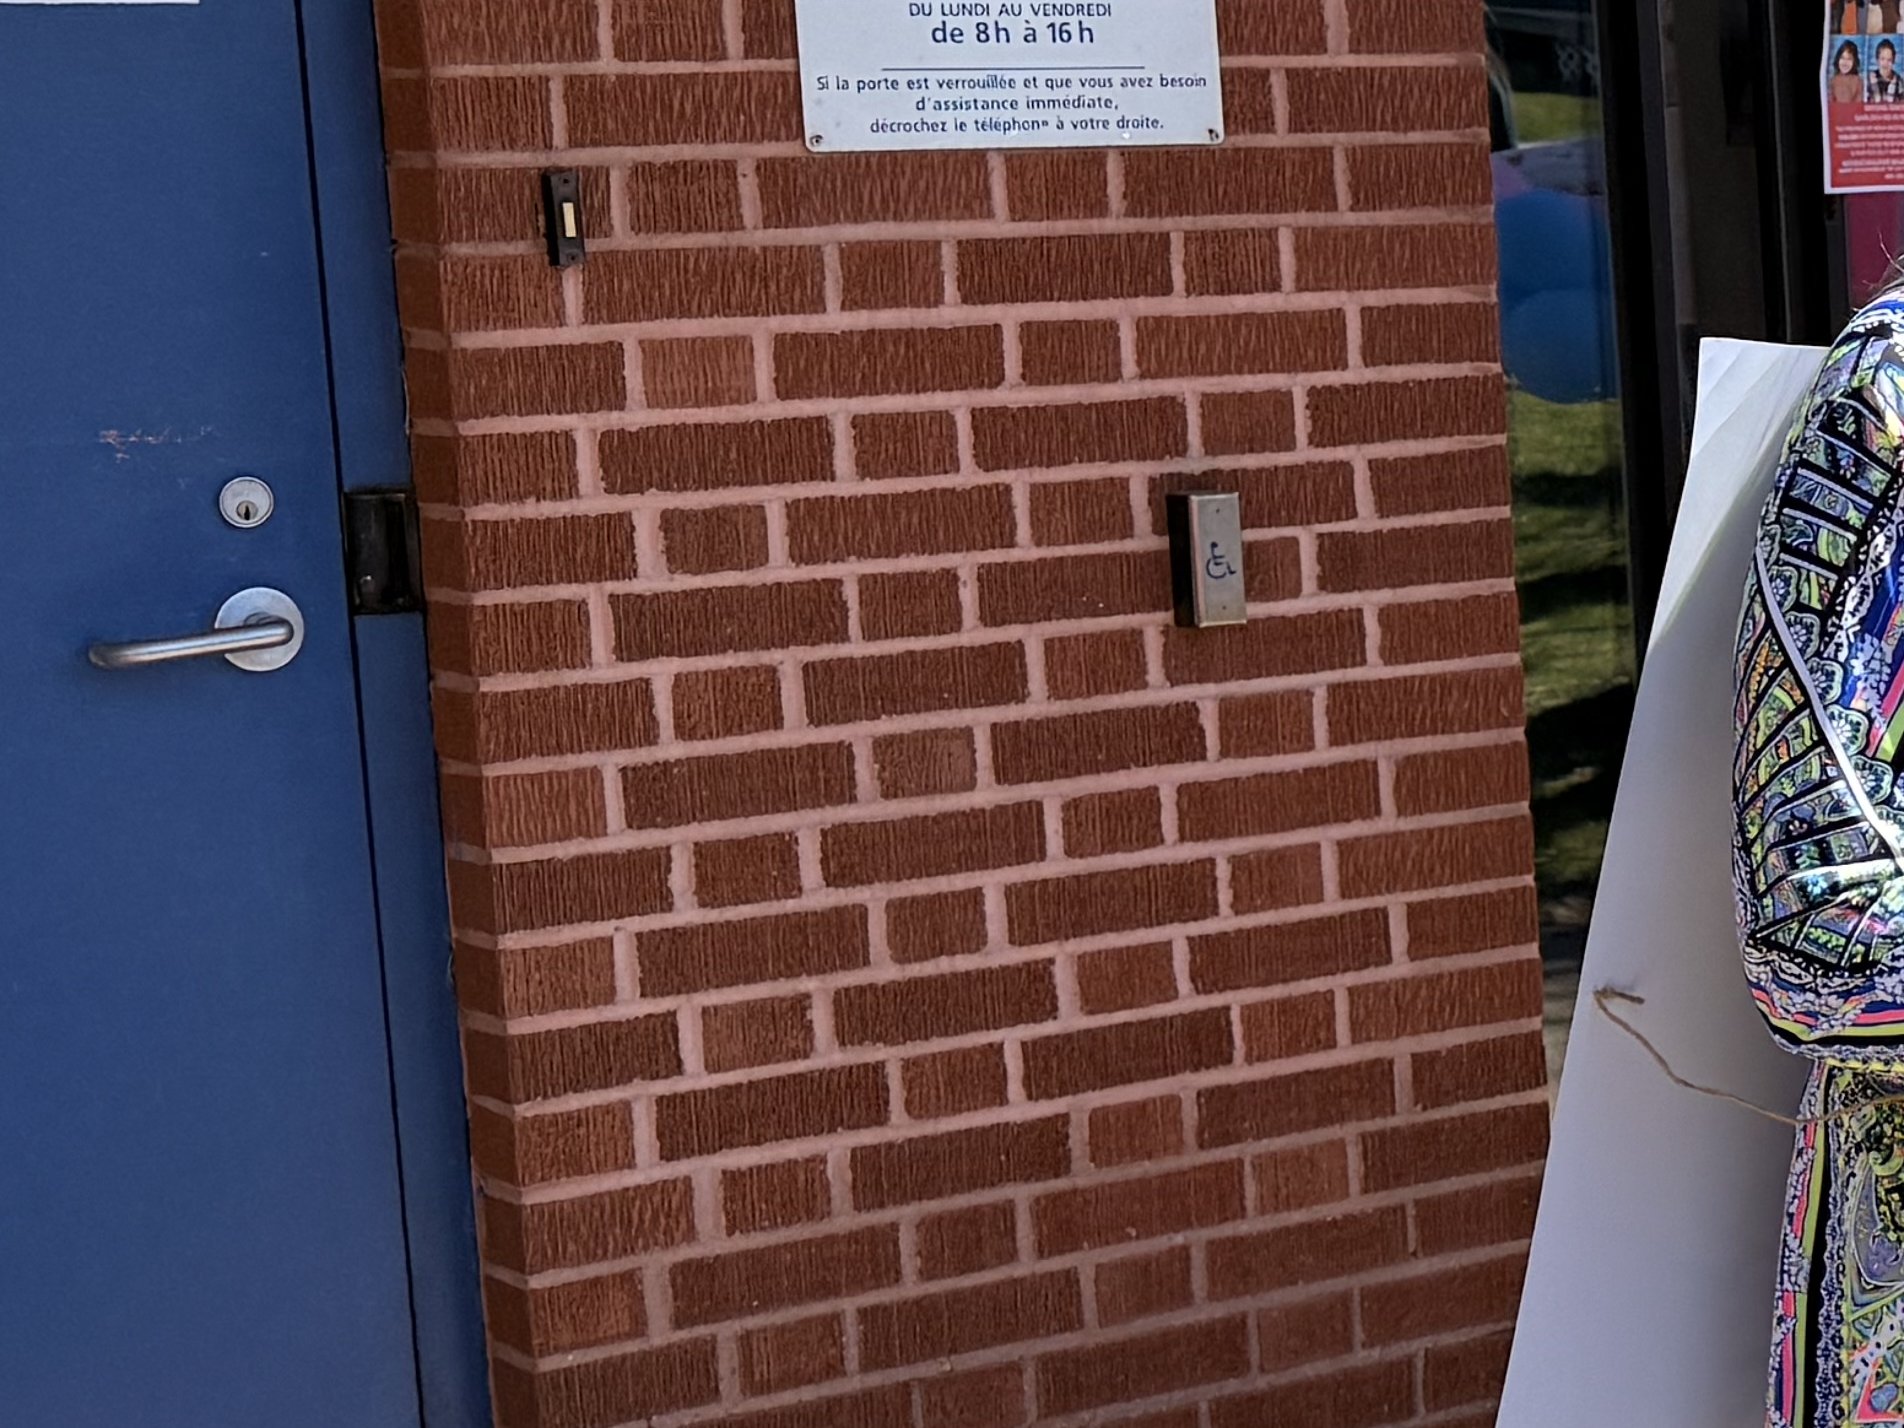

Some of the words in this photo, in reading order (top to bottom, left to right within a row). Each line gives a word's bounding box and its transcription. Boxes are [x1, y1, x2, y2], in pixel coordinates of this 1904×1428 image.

[909, 2, 933, 17] DU
[940, 2, 990, 17] LUNDI
[998, 2, 1022, 17] AU
[1030, 2, 1112, 17] VENDREDI
[931, 20, 964, 43] de
[1023, 19, 1037, 43] à
[816, 75, 829, 91] Si
[836, 75, 850, 90] la
[856, 76, 899, 93] porte
[906, 76, 929, 90] est
[936, 74, 1016, 90] verrouillée
[1023, 76, 1038, 89] et
[1045, 76, 1072, 91] que
[1079, 77, 1113, 89] vous
[1120, 76, 1153, 89] avez
[1159, 73, 1207, 88] besoin
[915, 95, 1019, 112] d'assistance
[1026, 94, 1119, 111] immédiate,
[870, 117, 947, 134] décrochez
[954, 117, 967, 132] le
[1056, 115, 1065, 131] à
[1070, 116, 1110, 130] votre
[1116, 114, 1164, 130] droite.
